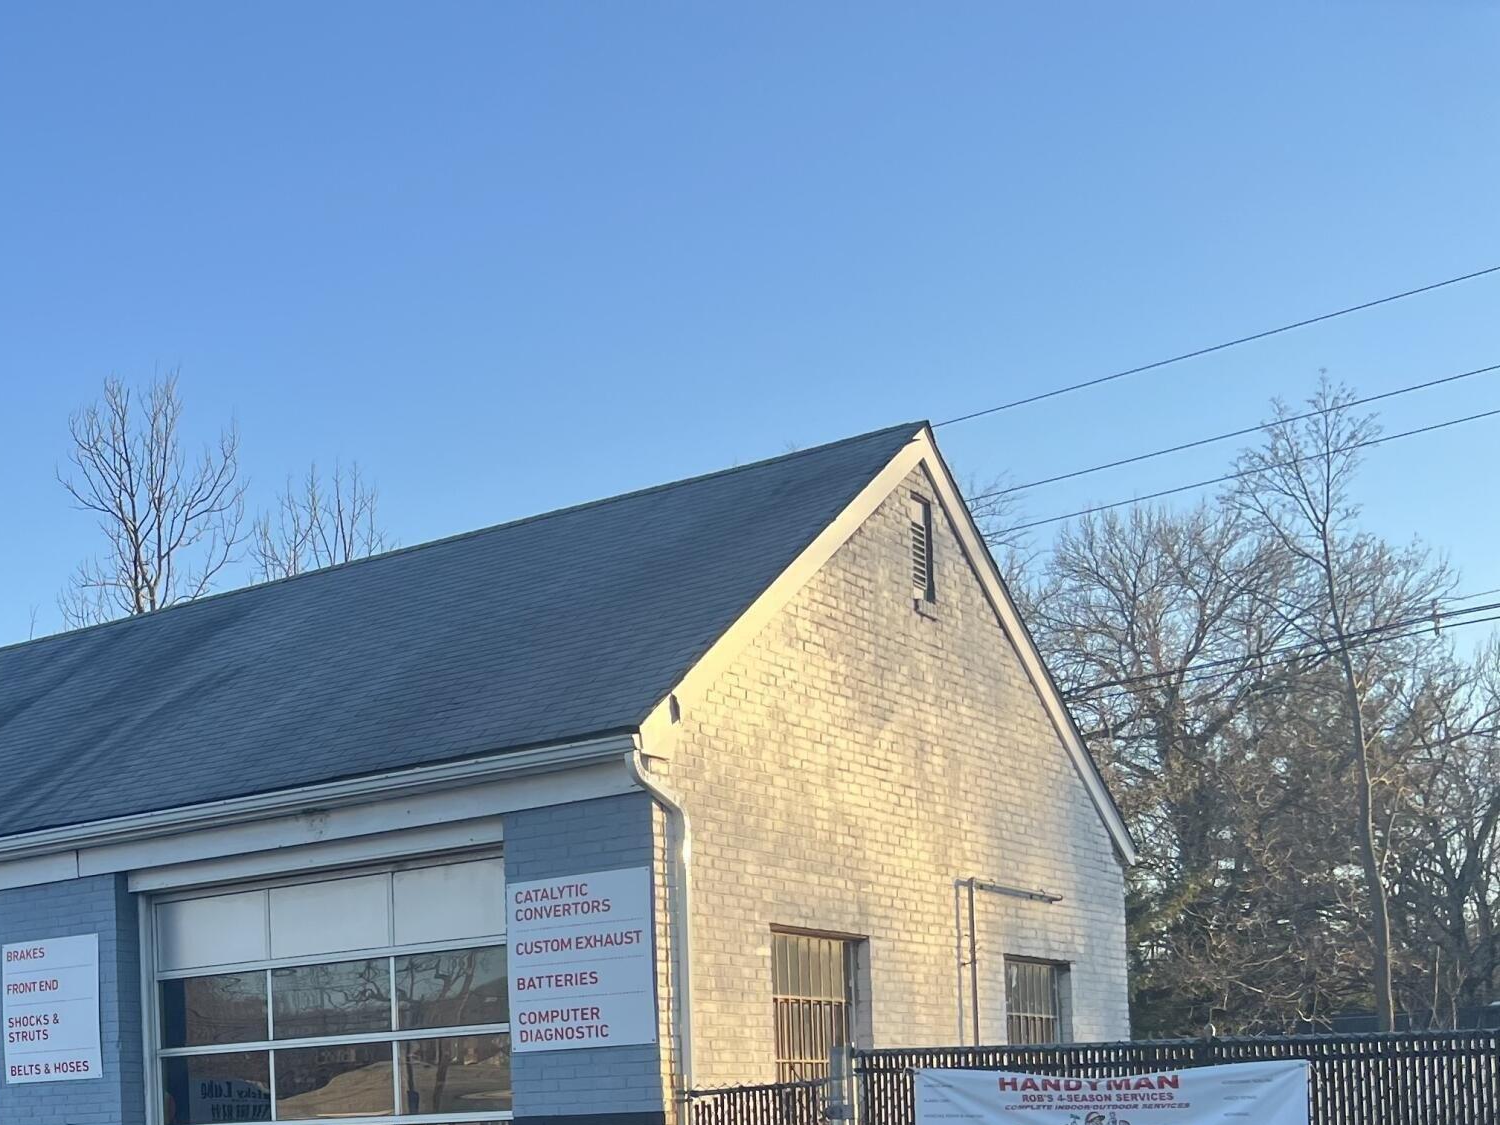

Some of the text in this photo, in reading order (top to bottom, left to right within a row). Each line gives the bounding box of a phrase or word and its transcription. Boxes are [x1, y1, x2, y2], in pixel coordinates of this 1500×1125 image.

[515, 883, 589, 904] CATALYTIC
[515, 899, 611, 922] CONVERTORS
[515, 930, 643, 956] CUSTOM EXHAUST
[6, 947, 45, 962] BRAKES
[7, 979, 59, 995] FRONT END
[517, 971, 599, 991] BATTERIES
[8, 1013, 60, 1029] SHOCKS &
[518, 1007, 601, 1025] COMPUTER
[8, 1029, 49, 1043] STRUTS
[520, 1024, 609, 1043] DIAGNOSTIC
[10, 1061, 90, 1077] BELTS & HOSES
[998, 1075, 1180, 1092] HANDYMAN
[1022, 1092, 1174, 1103] ROB'S 4-SEASON SERVICES
[1141, 1102, 1190, 1110] SERVICES
